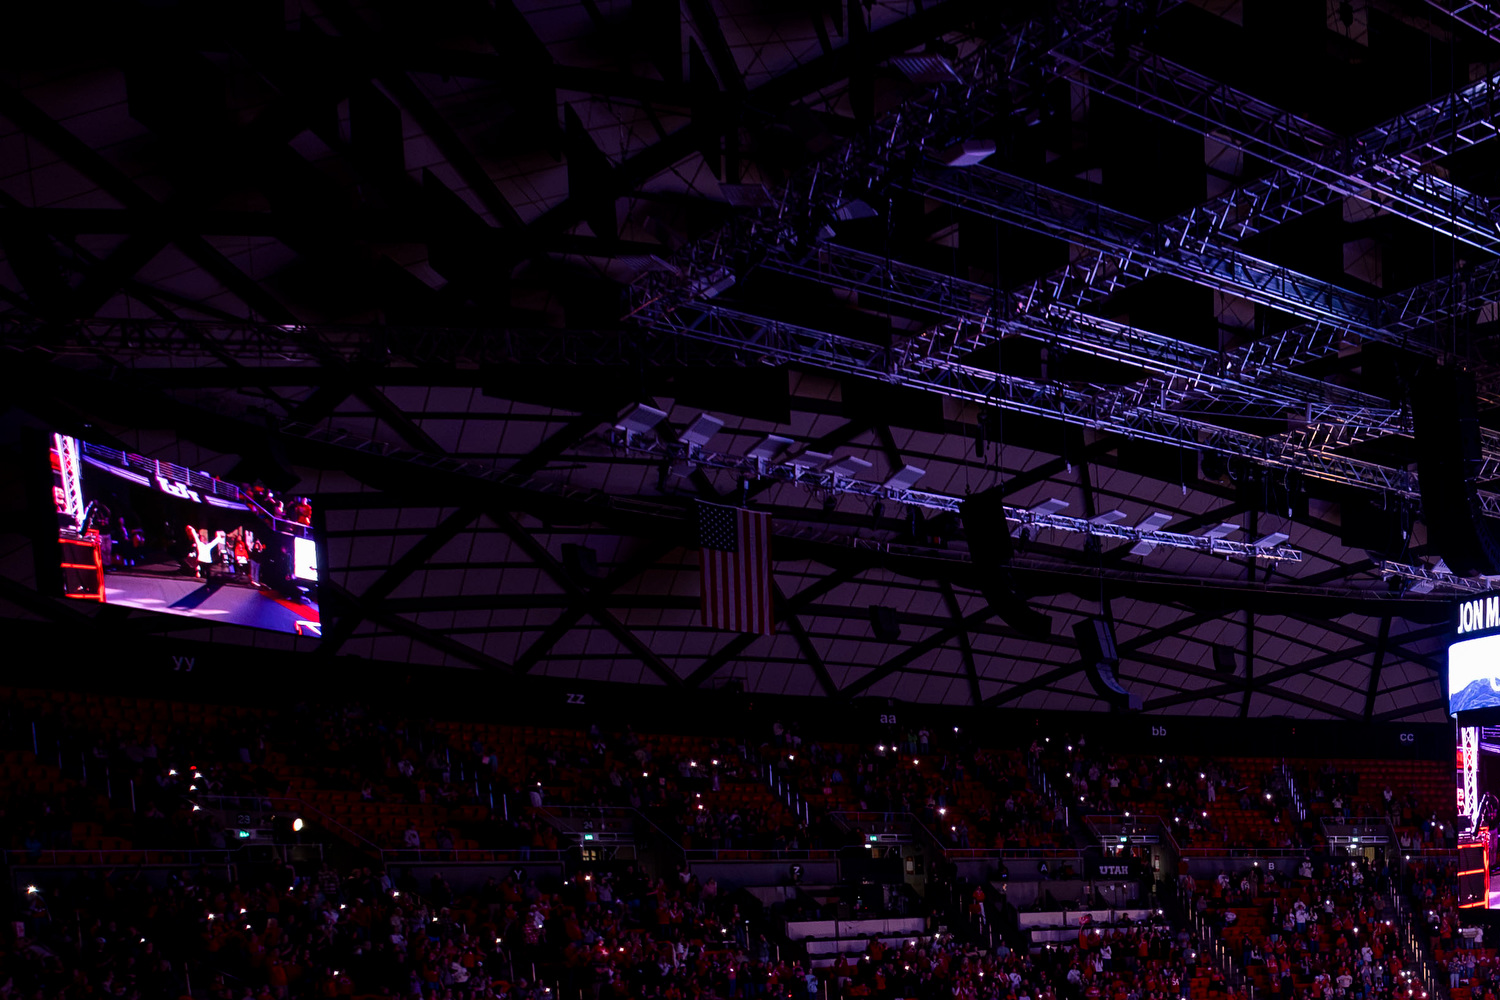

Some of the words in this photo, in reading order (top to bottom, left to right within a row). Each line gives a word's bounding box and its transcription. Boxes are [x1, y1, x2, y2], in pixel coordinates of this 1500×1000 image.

[1457, 599, 1483, 634] JON
[172, 655, 195, 672] yy
[567, 694, 585, 705] zz
[880, 714, 896, 724] aa
[1152, 726, 1167, 737] bb
[1399, 733, 1414, 742] cc
[1099, 865, 1128, 875] UTAH
[1268, 863, 1275, 871] B
